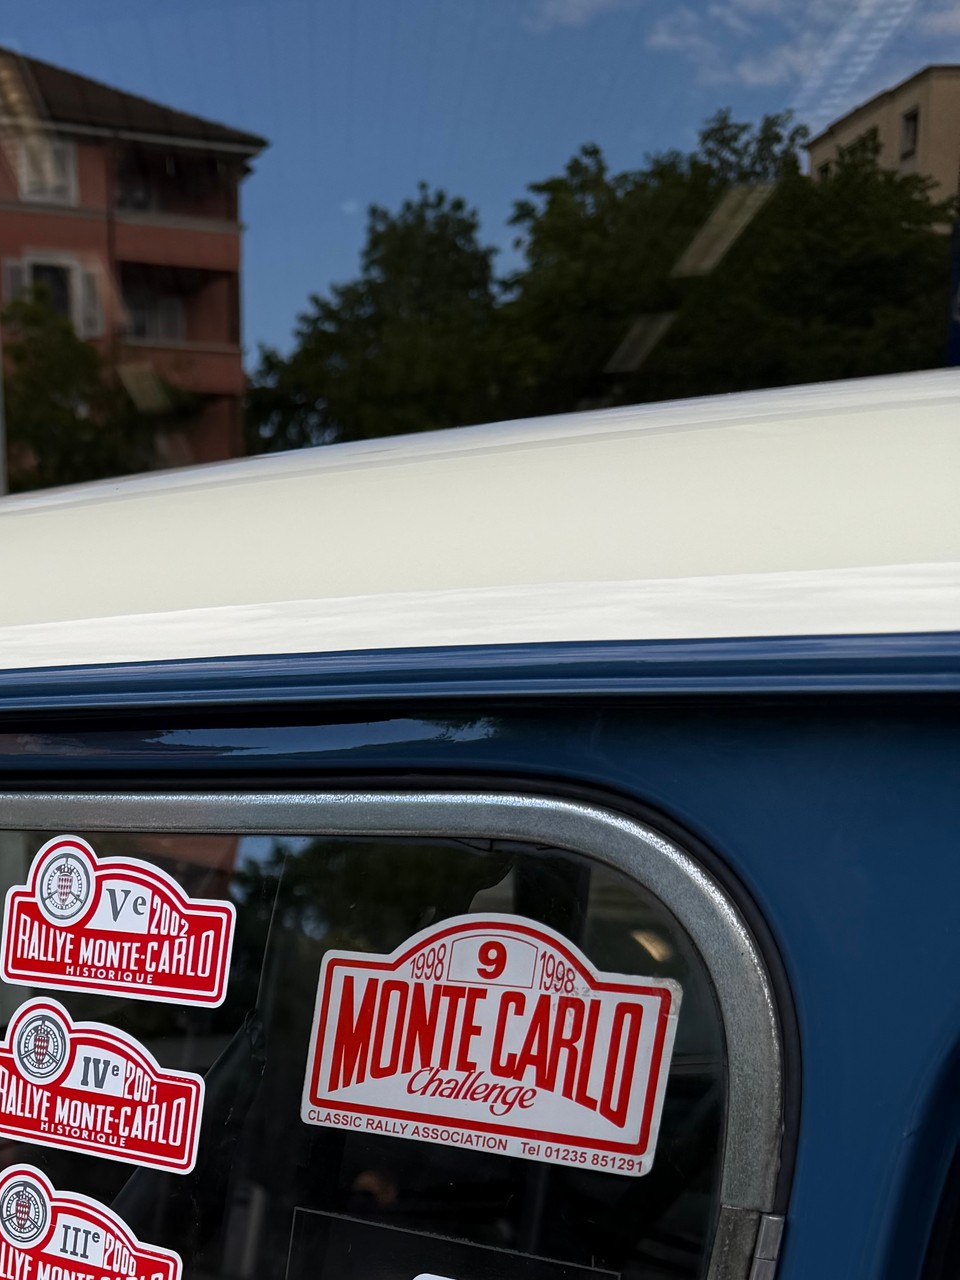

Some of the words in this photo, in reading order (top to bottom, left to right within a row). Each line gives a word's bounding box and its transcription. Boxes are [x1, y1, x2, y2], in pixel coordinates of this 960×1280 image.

[150, 894, 189, 938] 2002
[16, 913, 75, 964] RALLYE
[79, 930, 215, 978] MONTE-CARLO
[410, 943, 447, 982] 1998
[476, 940, 508, 980] 9
[66, 965, 154, 984] HISTORIQUE
[539, 950, 577, 994] 1998
[328, 975, 488, 1092] MONTE
[490, 991, 644, 1129] CARLO
[124, 1060, 158, 1105] 2001
[406, 1066, 537, 1117] Challenge
[40, 1120, 127, 1147] HISTORIQUE
[54, 1096, 187, 1147] MONTE-CARLO
[307, 1109, 363, 1130] CLASSIC
[365, 1116, 409, 1136] RALLY
[410, 1124, 508, 1151] ASSOCIATION
[520, 1141, 541, 1157] Tel
[544, 1146, 588, 1165] 01235
[591, 1152, 643, 1173] 851291
[103, 1231, 137, 1276] 2000
